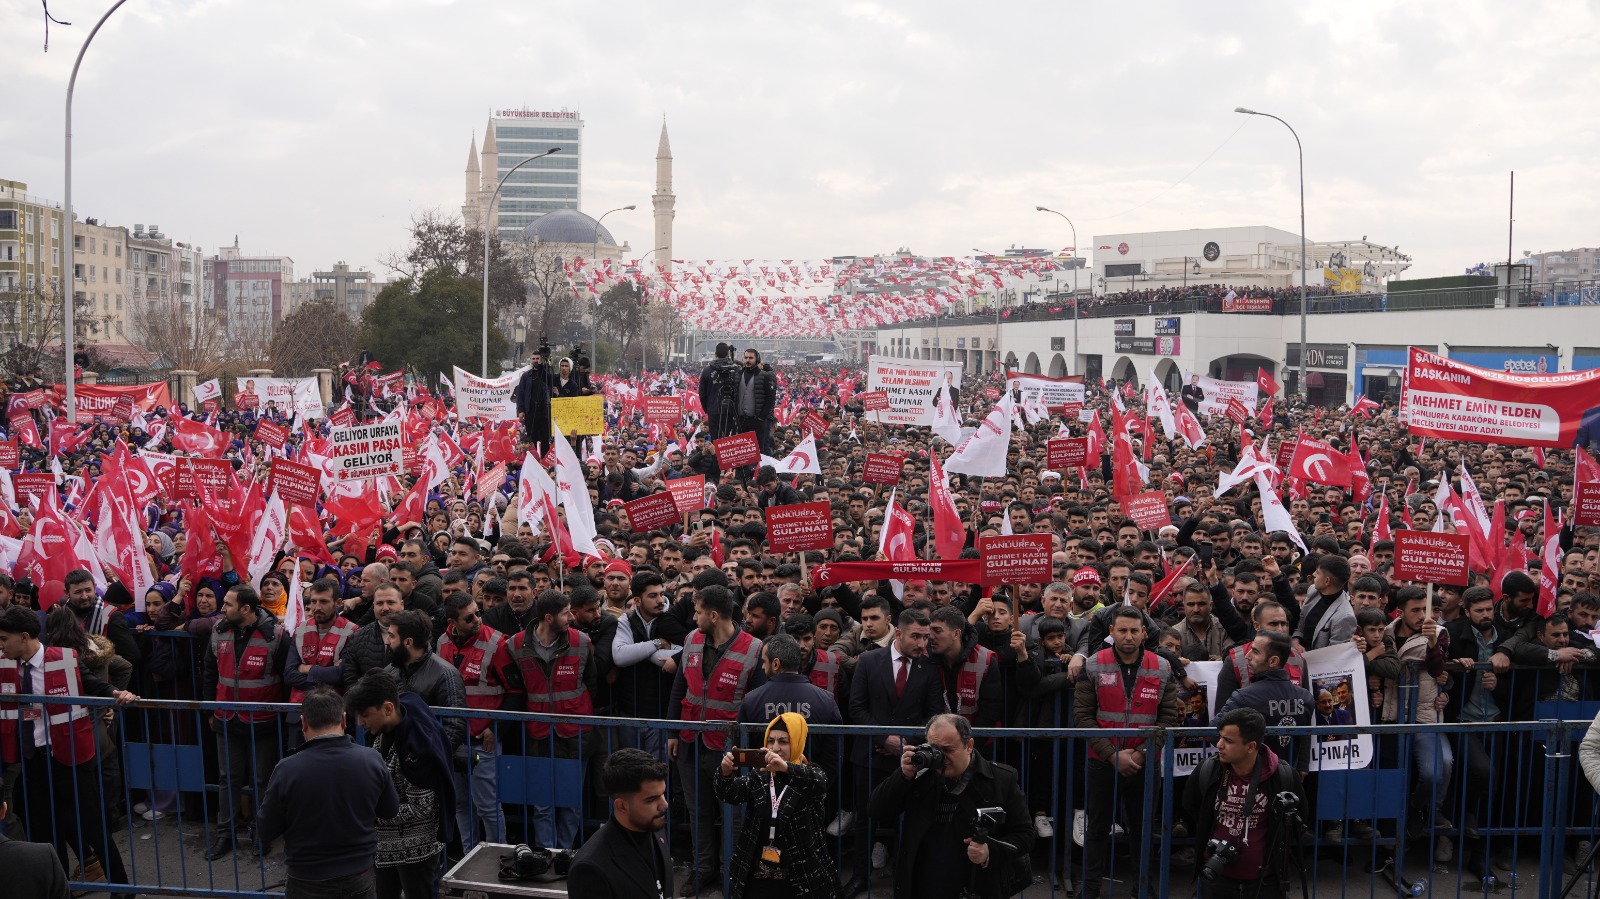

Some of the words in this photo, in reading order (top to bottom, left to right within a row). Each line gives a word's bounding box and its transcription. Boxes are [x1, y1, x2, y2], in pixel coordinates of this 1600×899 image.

[502, 109, 540, 118] BÜYÜKŞEHİR
[541, 110, 576, 119] BELEDİYESİ
[1504, 359, 1537, 371] ebebek
[1414, 367, 1471, 385] BAŞKANIM
[875, 386, 906, 395] MEHMET
[908, 388, 933, 396] KASIM
[1413, 395, 1462, 410] MEHMET
[1465, 400, 1497, 415] EMİN
[1501, 405, 1541, 419] ELDEN
[1412, 408, 1450, 420] ŞANLIURFA
[1451, 414, 1498, 425] KARAKÖPRÜ
[1500, 420, 1540, 429] BELEDİYESİ
[1412, 418, 1435, 428] MECLİS
[1436, 420, 1456, 430] ÜYESİ
[1458, 424, 1479, 433] ADAY
[1480, 426, 1503, 435] ADAYI
[334, 428, 368, 443] GELİYOR
[369, 425, 399, 439] URFAYA
[333, 441, 370, 458] KASIM
[372, 438, 400, 453] PAŞA
[343, 454, 393, 468] GELİYOR
[770, 510, 816, 521] ŞANLIURFA
[772, 521, 803, 530] MEHMET
[985, 541, 1037, 551] ŞANLIURFA
[1401, 537, 1453, 548] ŞANLIURFA
[1401, 549, 1437, 557] MEHMET
[1438, 552, 1465, 560] KASIM
[1311, 744, 1360, 761] LPINAR
